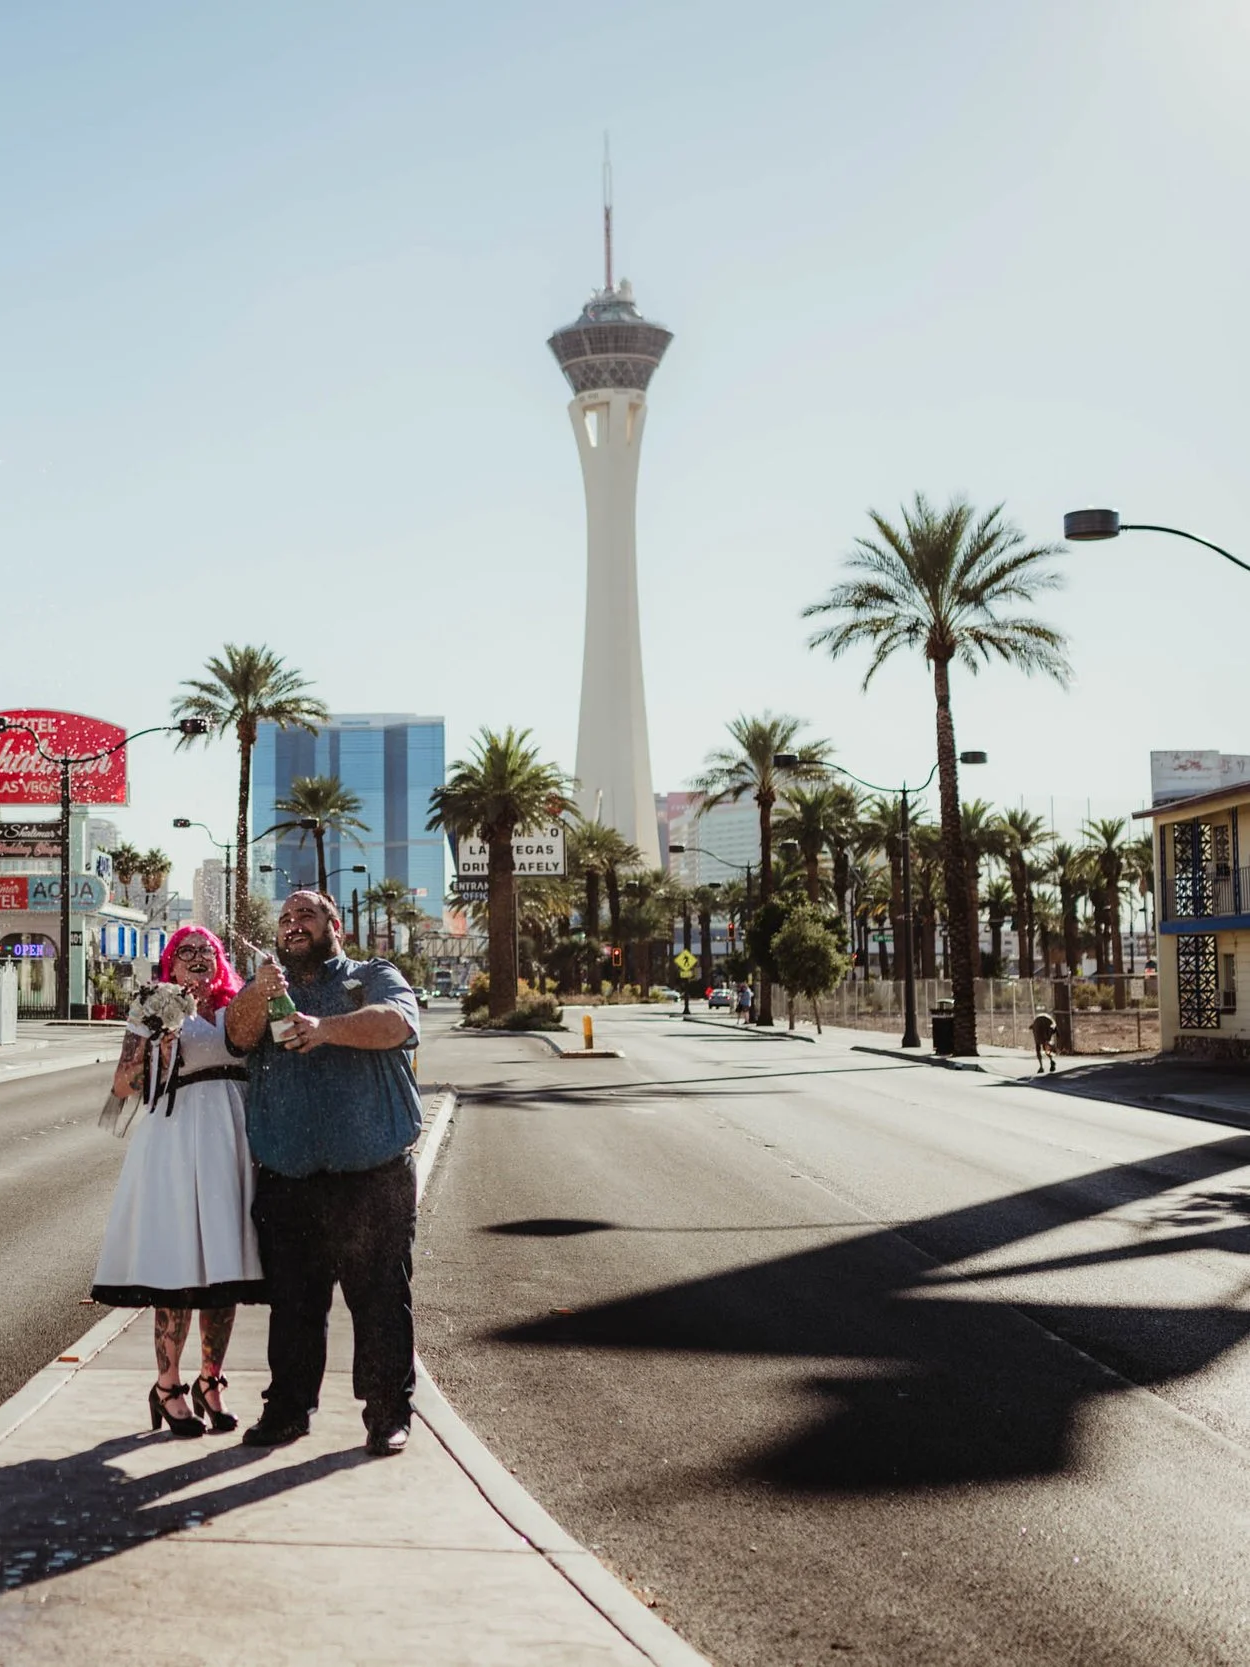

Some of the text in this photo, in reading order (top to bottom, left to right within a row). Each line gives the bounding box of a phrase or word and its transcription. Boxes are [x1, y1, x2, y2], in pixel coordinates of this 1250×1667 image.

[6, 717, 58, 733] HOTEL
[470, 846, 554, 855] LA EGAS
[462, 862, 560, 872] DRI AFELY
[453, 882, 489, 891] ENTRAN
[463, 892, 489, 900] OFFIC
[14, 944, 44, 956] OPEN
